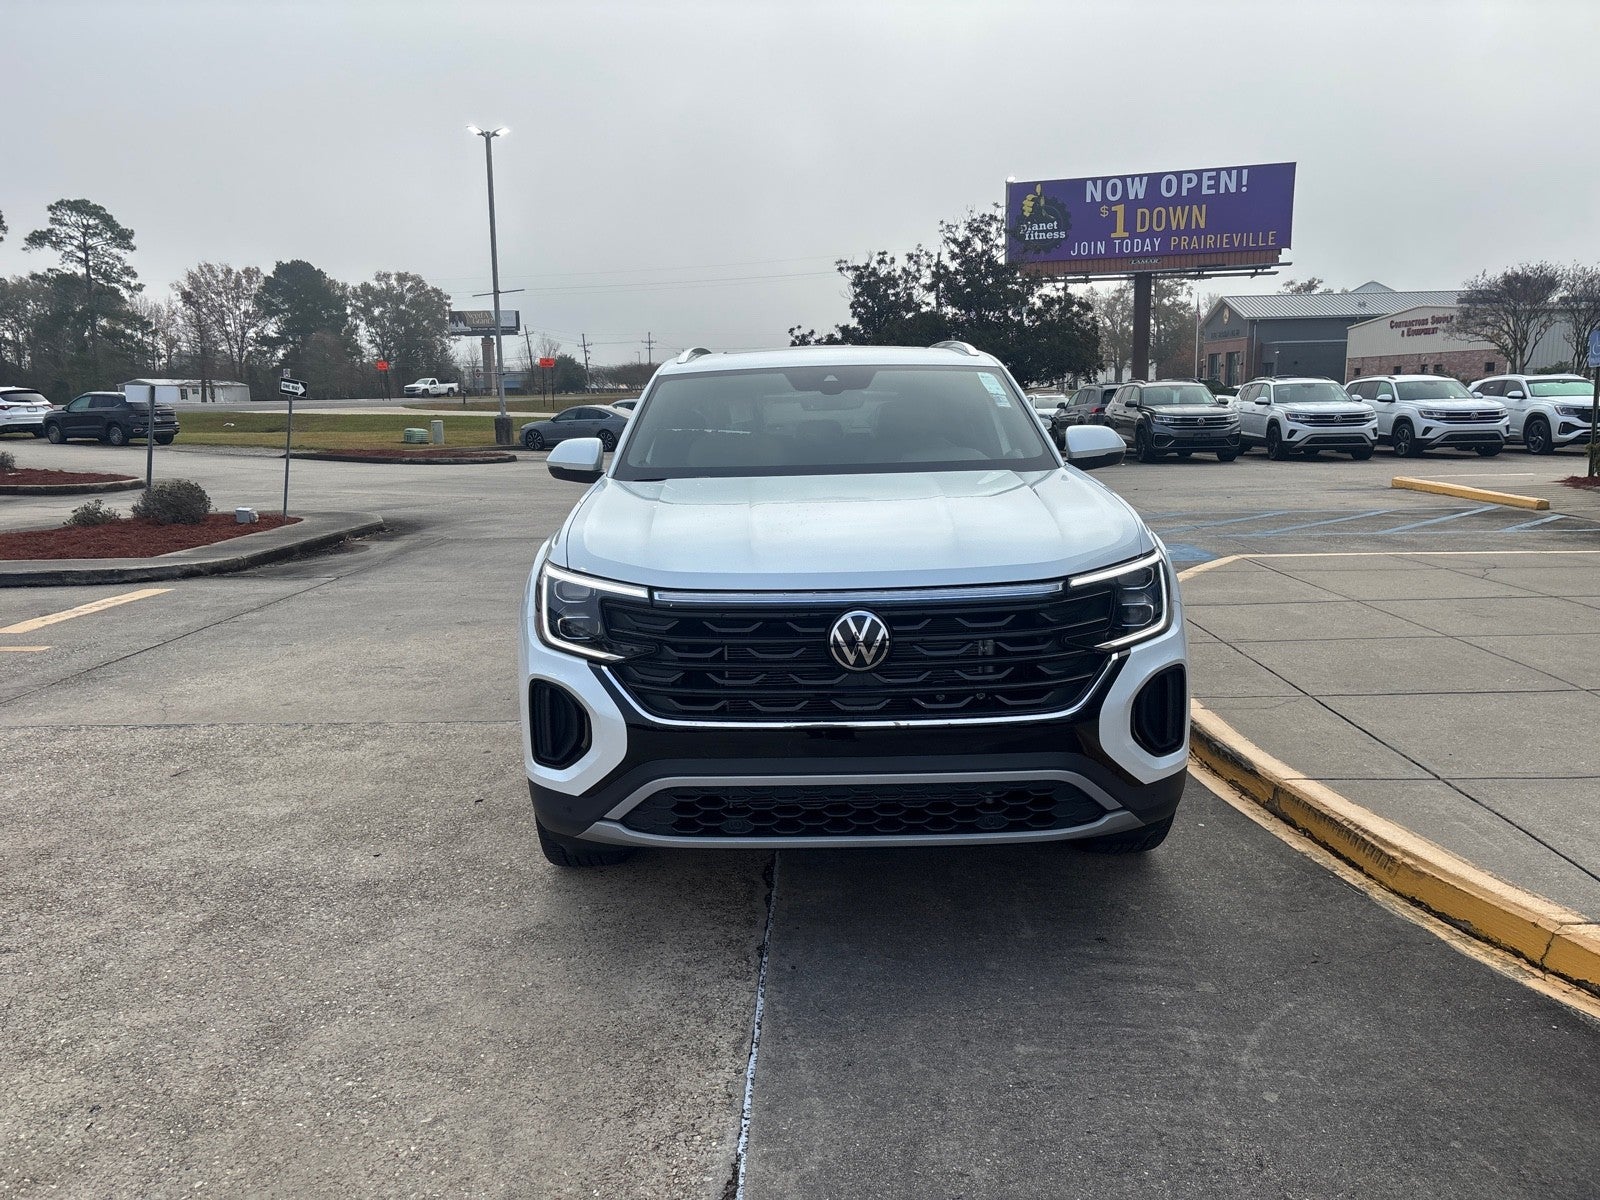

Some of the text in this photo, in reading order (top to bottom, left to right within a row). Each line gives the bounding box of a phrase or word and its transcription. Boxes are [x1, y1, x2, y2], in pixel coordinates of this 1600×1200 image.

[1085, 168, 1250, 203] NOW OPEN!
[1136, 204, 1208, 233] DOWN
[1024, 230, 1067, 241] fitness
[1070, 231, 1278, 257] JOIN TODAY PRAIRIEVILLE
